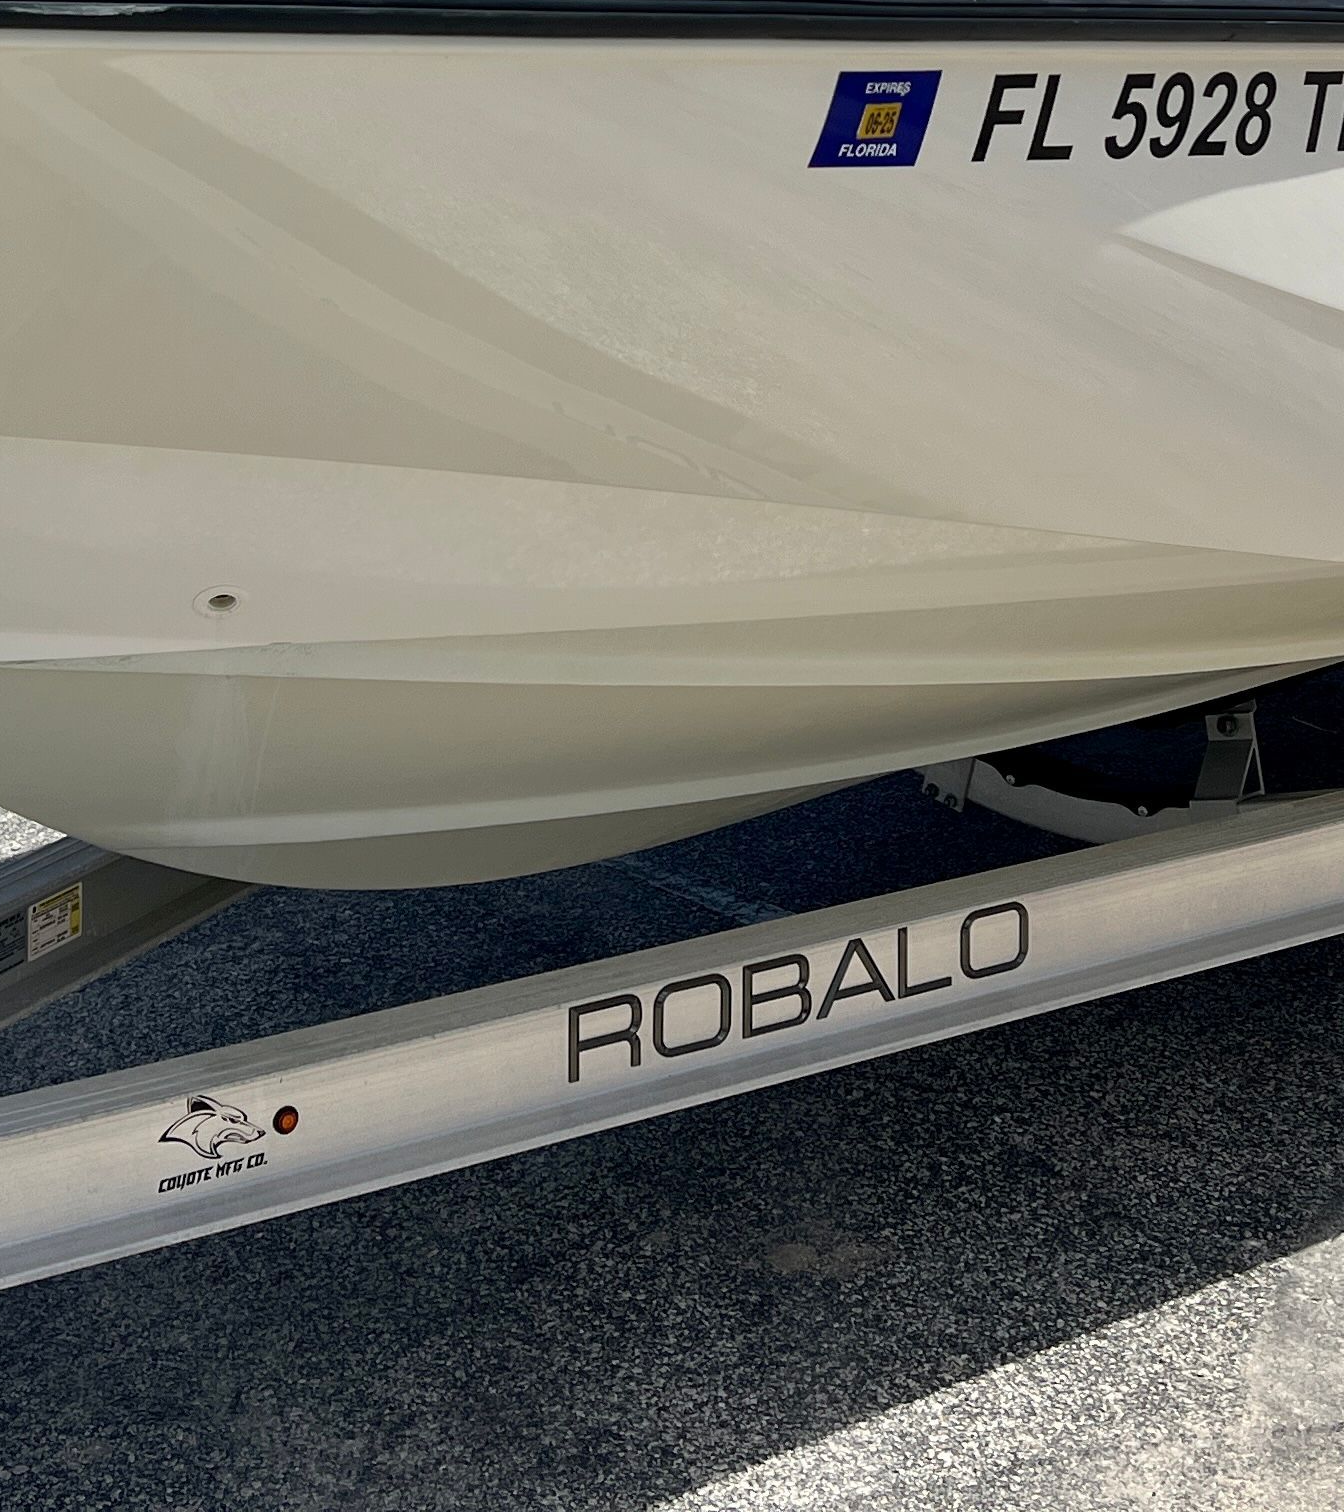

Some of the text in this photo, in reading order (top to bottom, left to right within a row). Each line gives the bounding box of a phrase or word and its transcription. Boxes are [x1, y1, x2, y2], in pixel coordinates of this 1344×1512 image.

[865, 81, 912, 96] EXPIRES
[971, 73, 1074, 162] FL
[1104, 71, 1277, 160] 5928
[838, 143, 897, 157] FLORIDA
[568, 901, 1029, 1083] ROBALO
[158, 1152, 268, 1193] COYOTE MFG CO.
